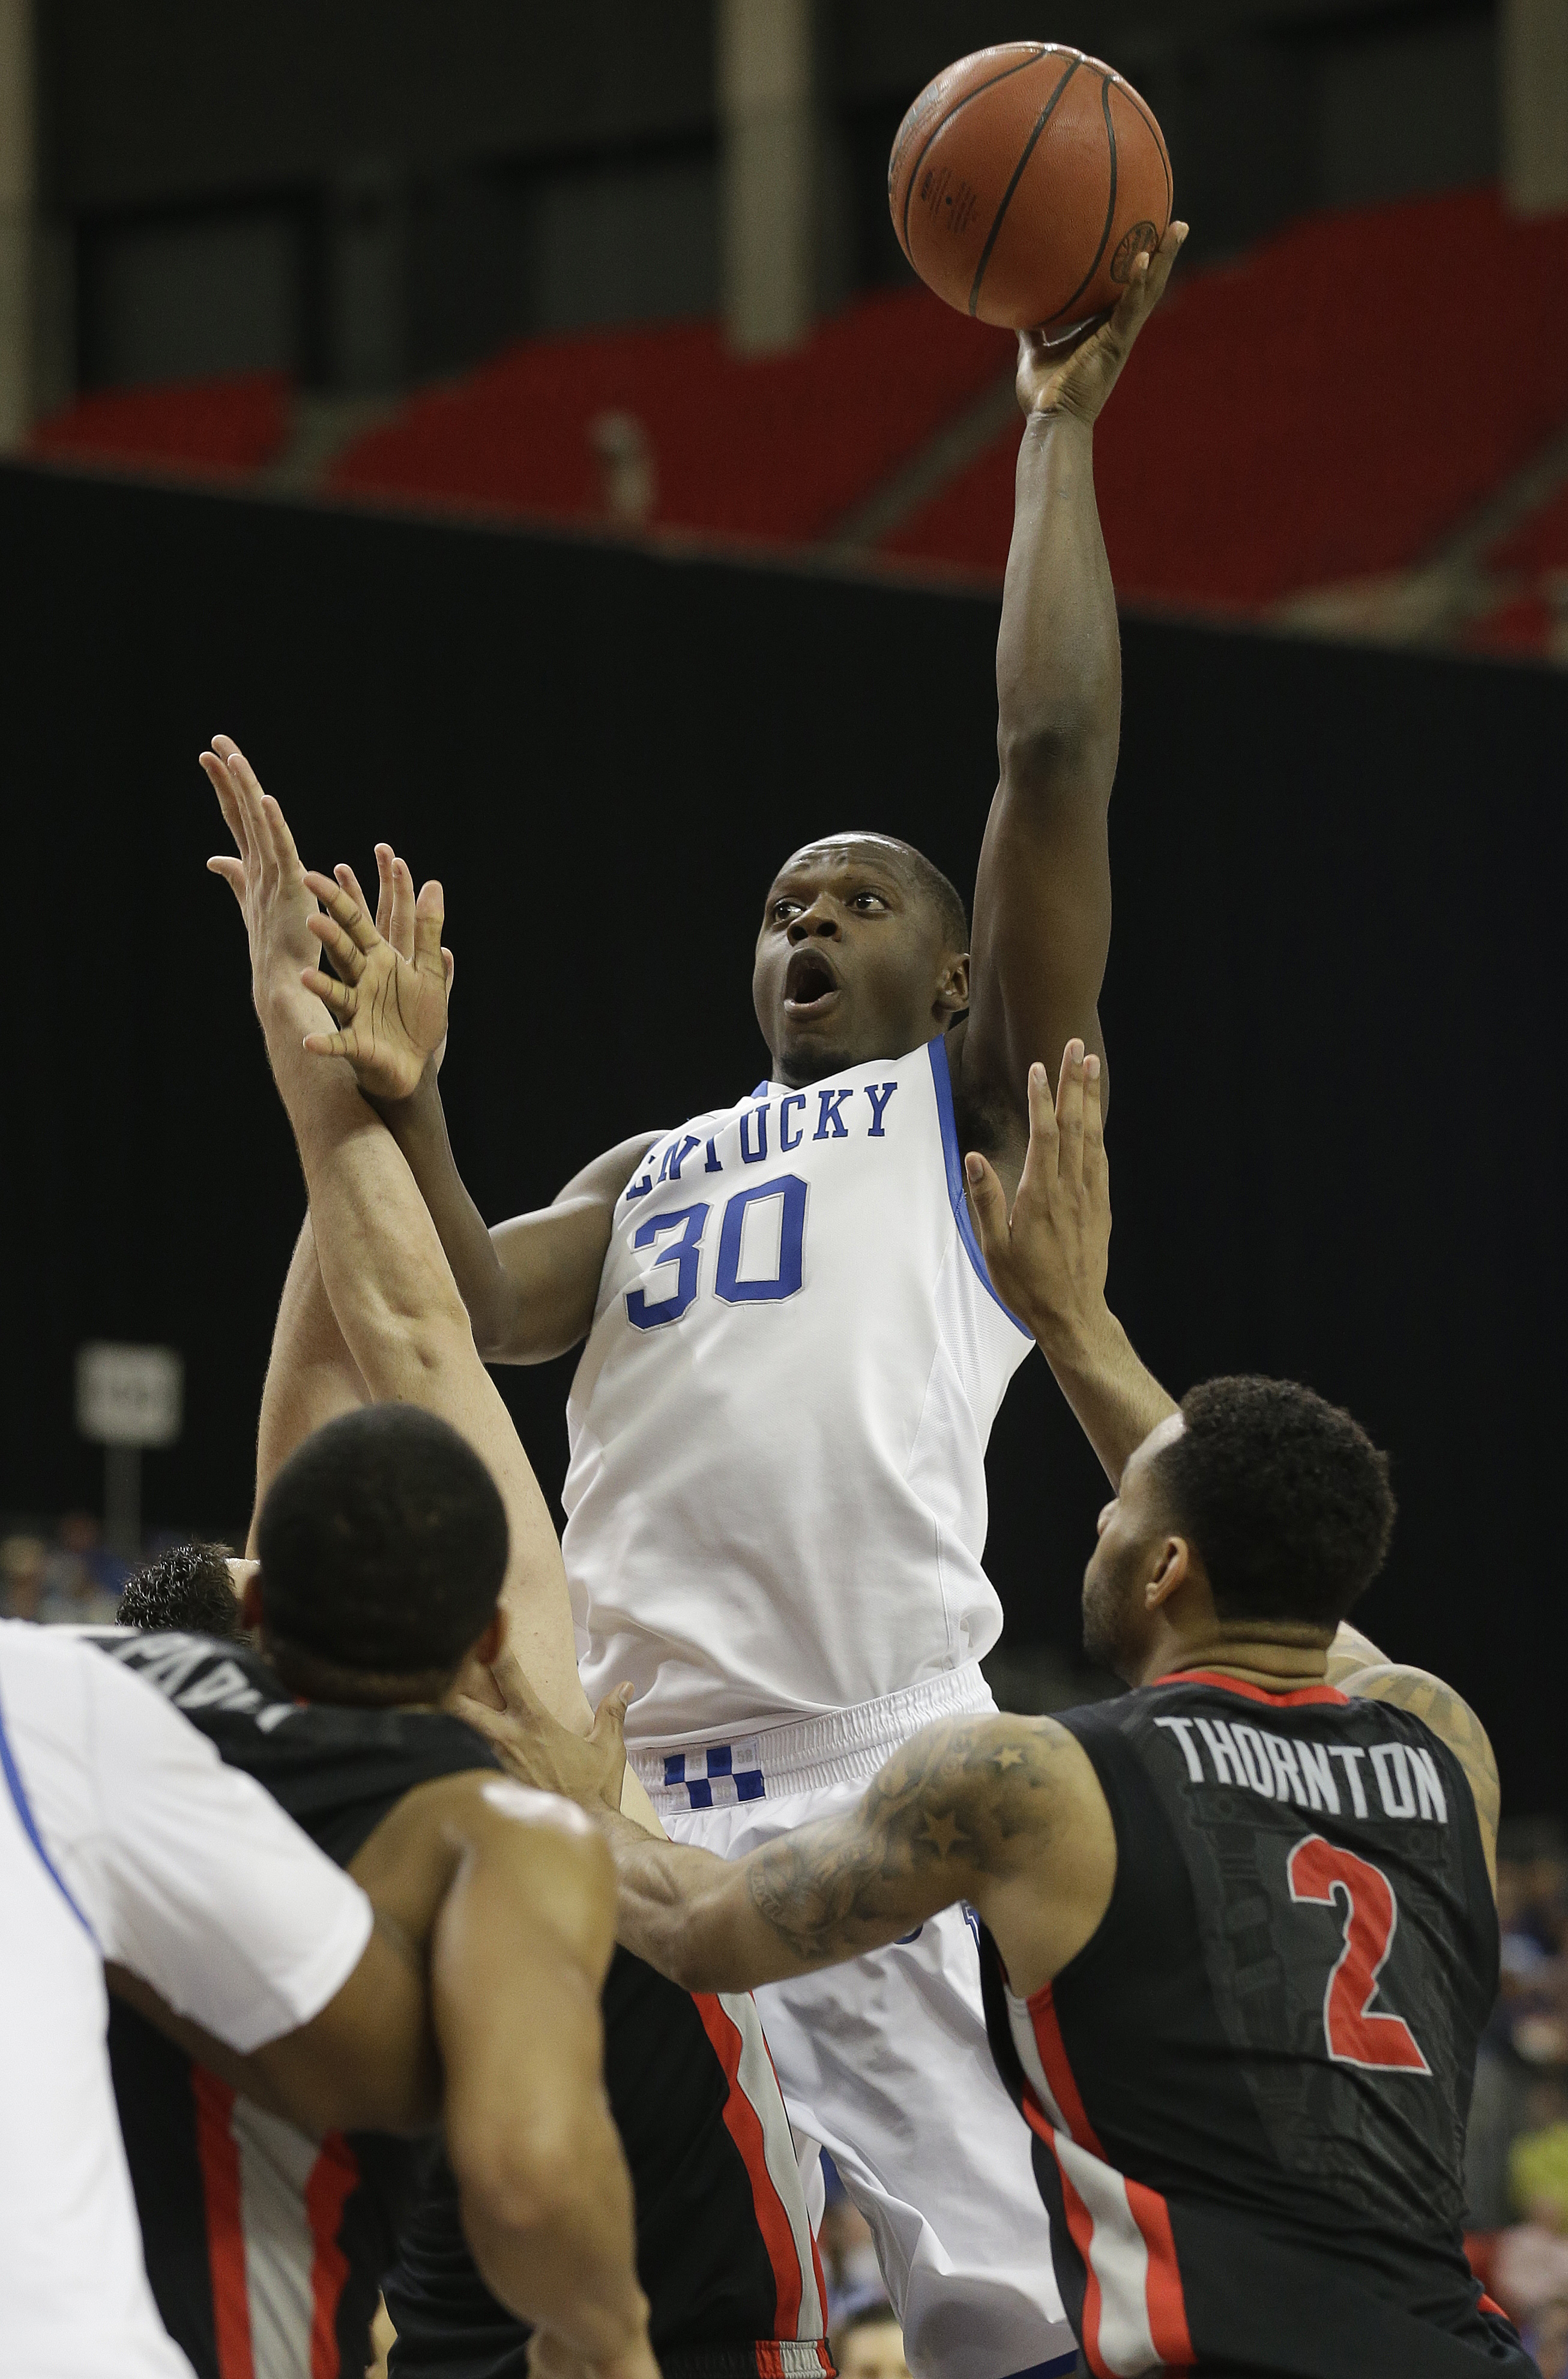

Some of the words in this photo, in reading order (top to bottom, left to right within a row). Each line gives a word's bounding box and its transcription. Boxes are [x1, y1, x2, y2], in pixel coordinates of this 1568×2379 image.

[624, 1172, 810, 1333] 30
[1154, 1716, 1448, 1824] THORNTON
[1287, 1833, 1433, 2075] 2
